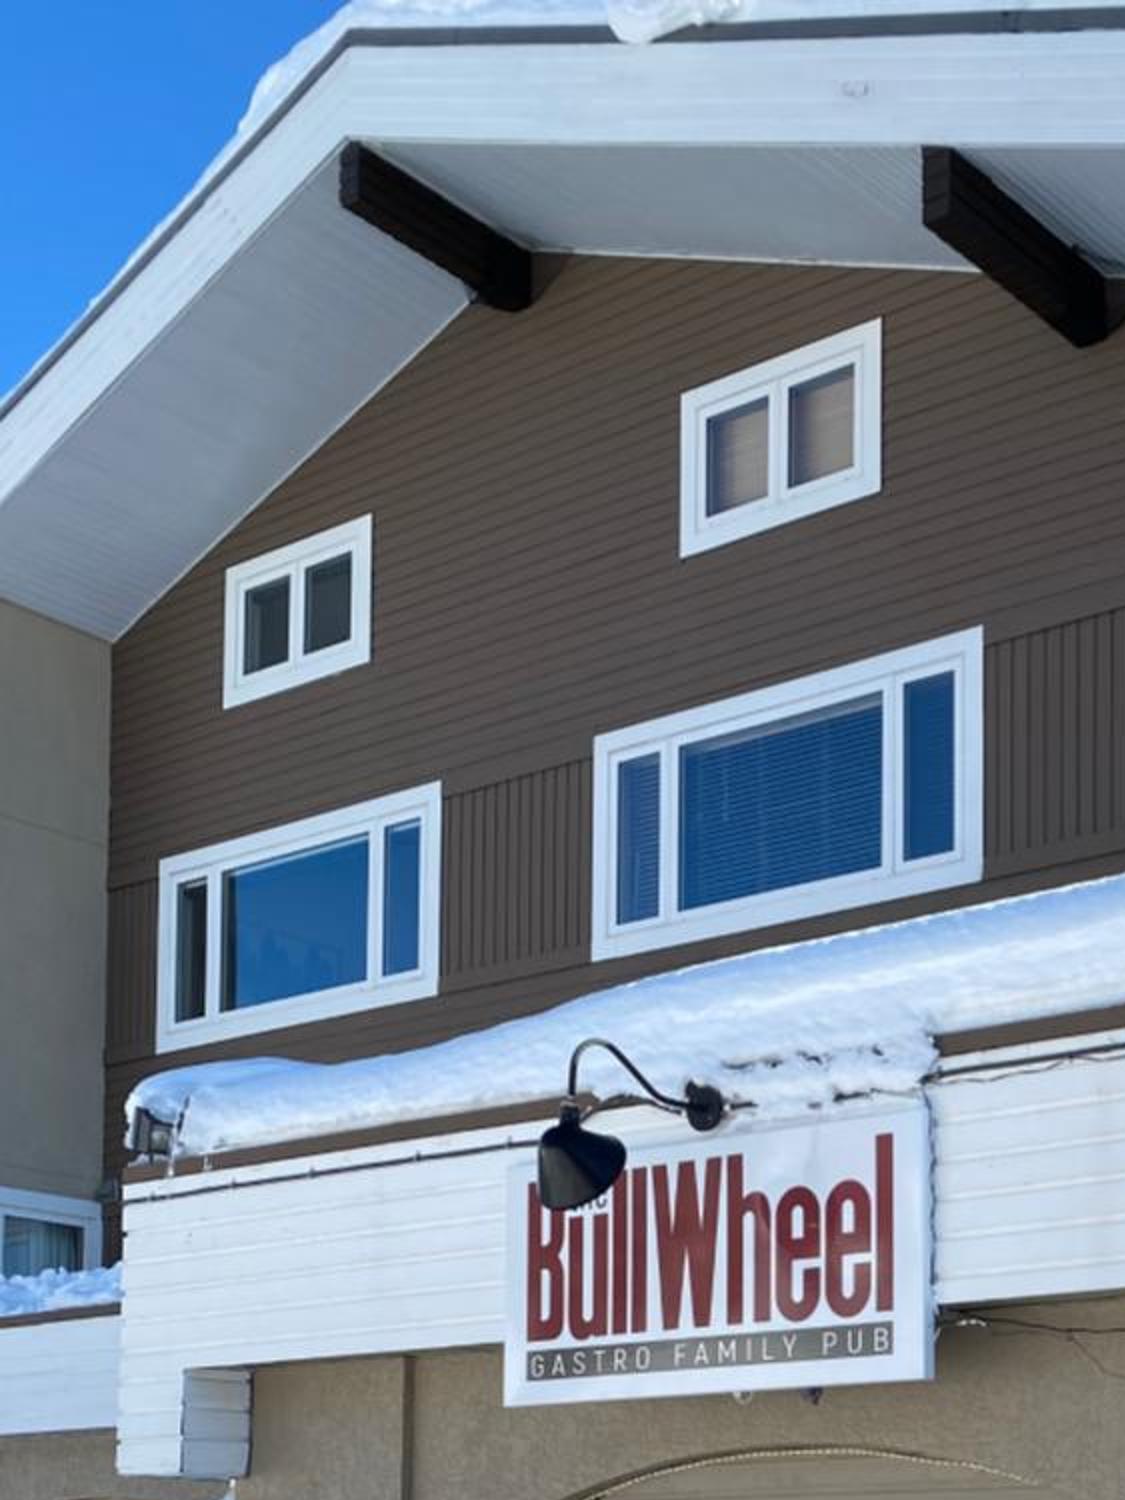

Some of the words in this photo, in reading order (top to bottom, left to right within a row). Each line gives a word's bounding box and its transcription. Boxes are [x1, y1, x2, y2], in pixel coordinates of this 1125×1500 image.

[527, 1133, 893, 1341] BullWheel
[531, 1346, 651, 1378] GASTRO
[674, 1335, 797, 1362] FAMILY
[823, 1329, 889, 1355] PUB
